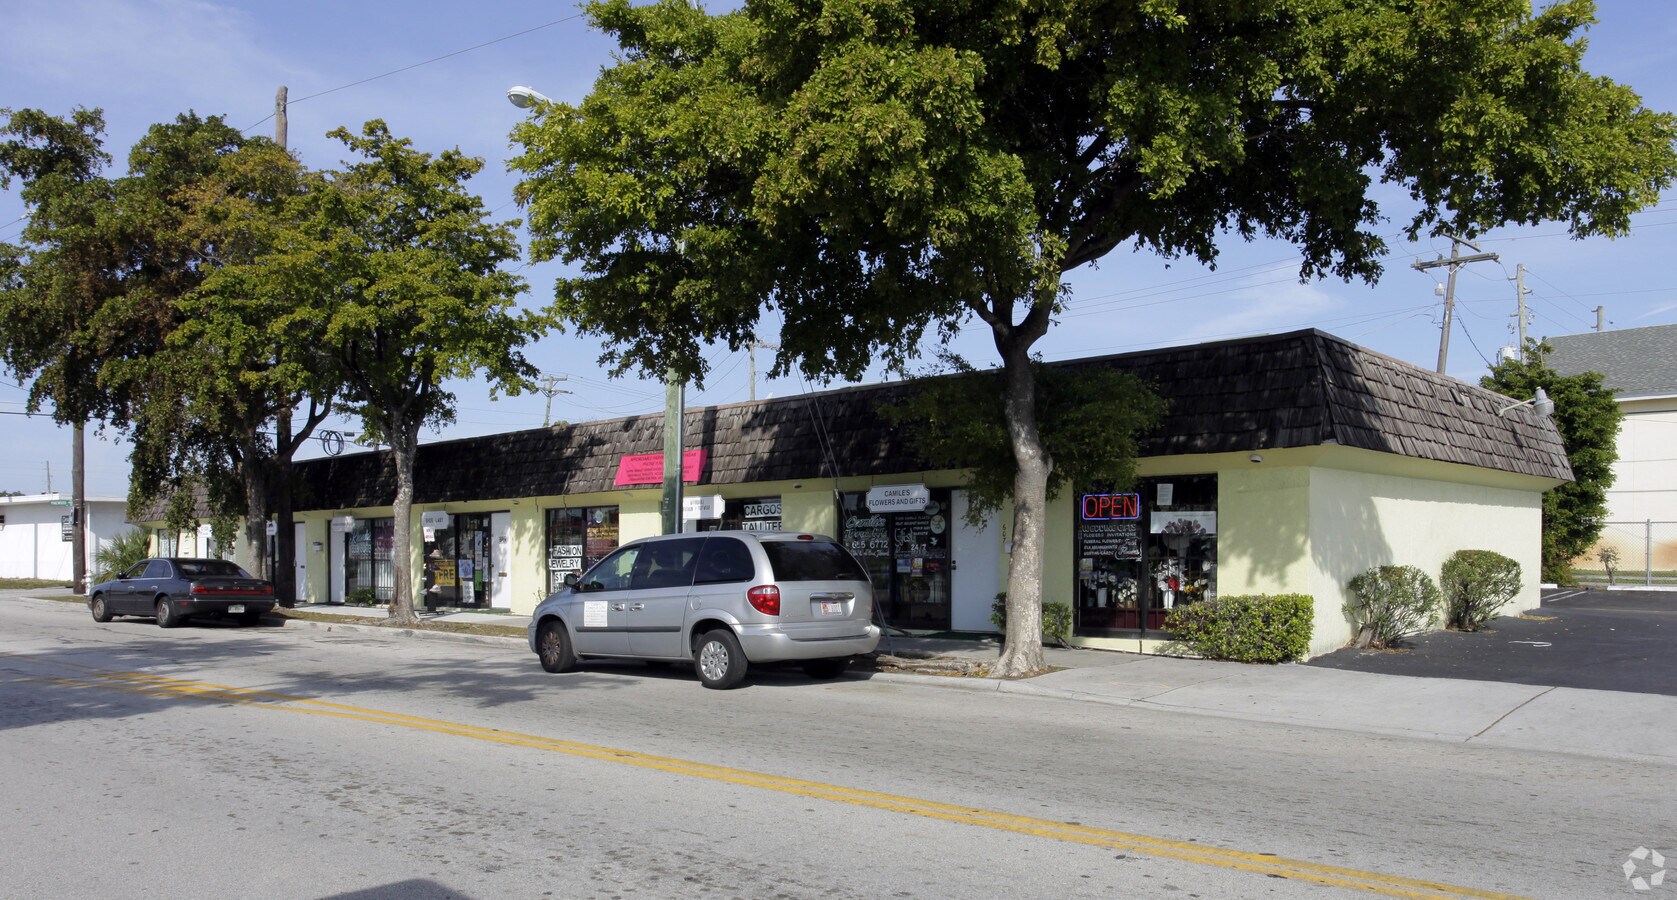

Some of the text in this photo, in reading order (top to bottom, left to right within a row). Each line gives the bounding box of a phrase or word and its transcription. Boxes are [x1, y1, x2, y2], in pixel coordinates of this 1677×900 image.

[909, 497, 926, 505] GIFTS
[1084, 495, 1137, 517] OPEN
[745, 503, 782, 516] CARGOS
[553, 546, 582, 556] FASHION
[549, 559, 579, 568] JEWELRY
